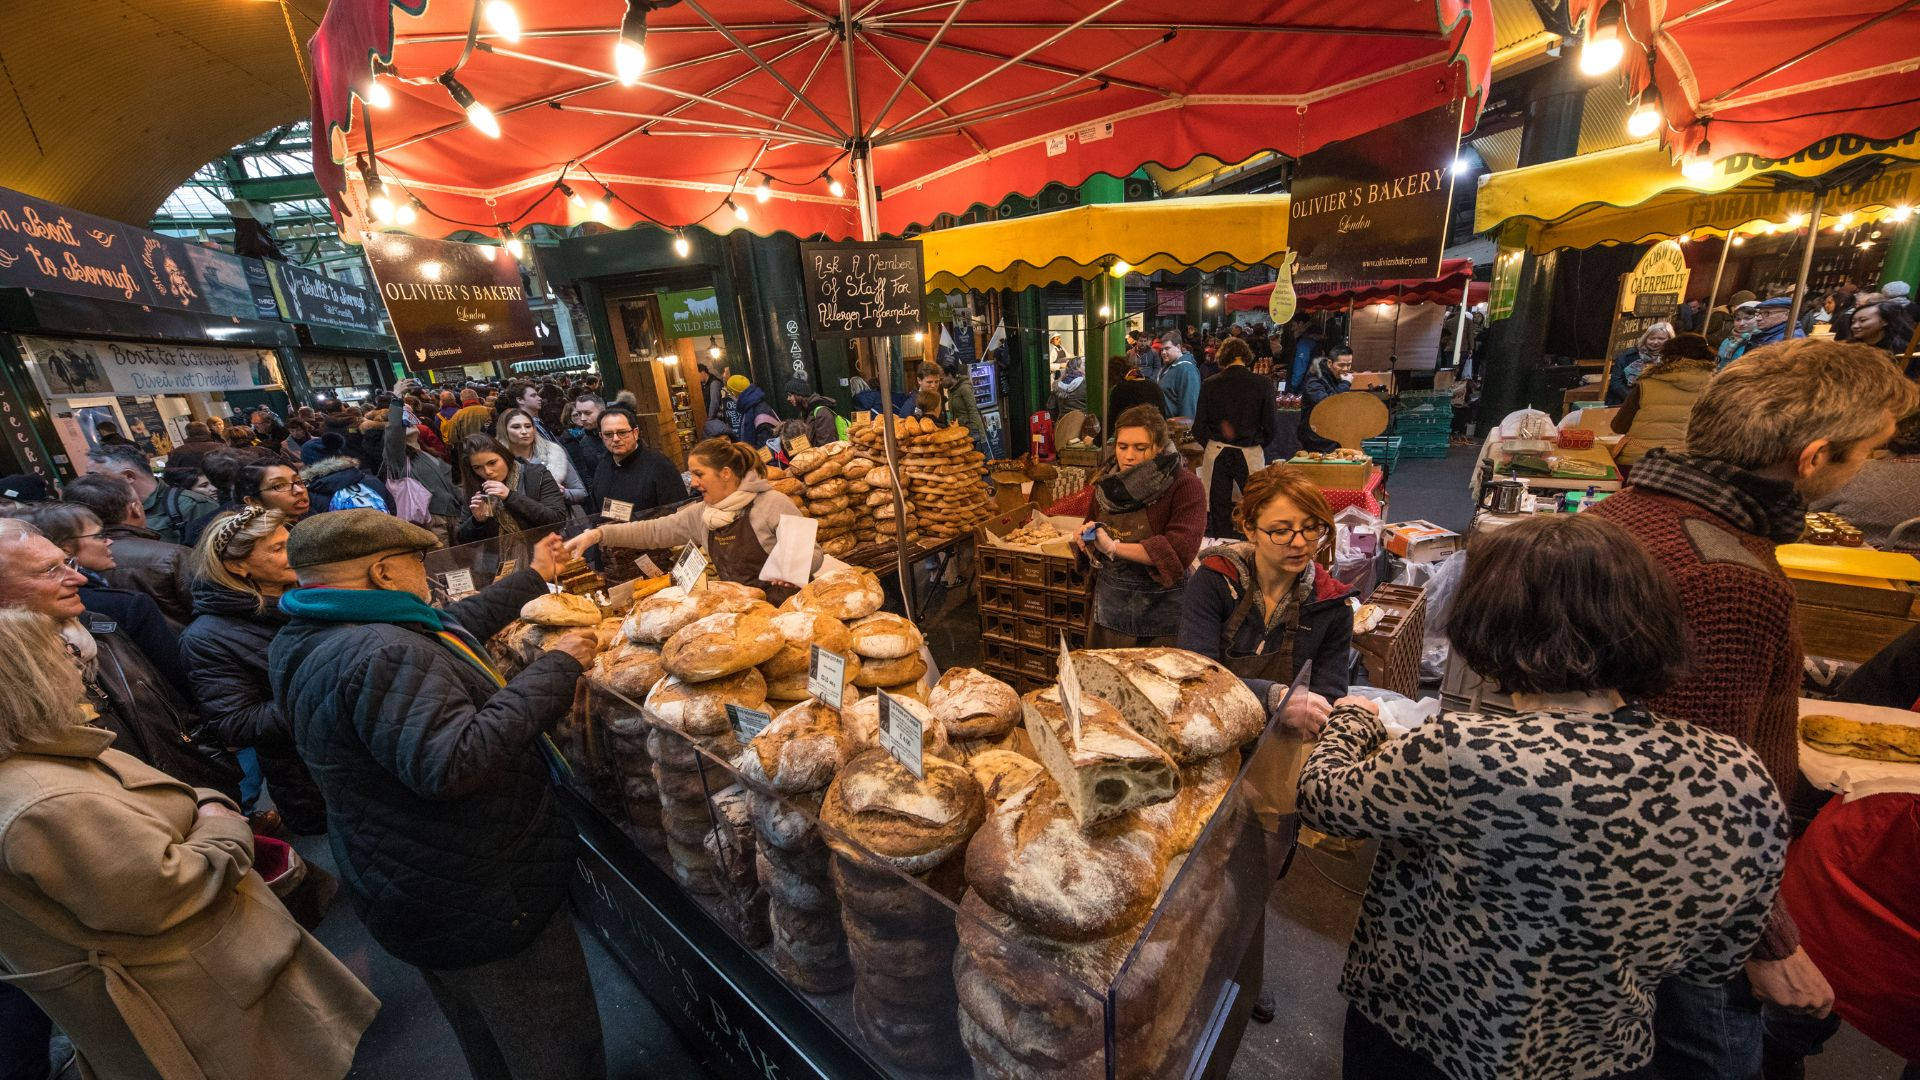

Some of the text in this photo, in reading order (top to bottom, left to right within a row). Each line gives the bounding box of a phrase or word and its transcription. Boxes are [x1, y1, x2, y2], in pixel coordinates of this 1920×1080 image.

[1292, 168, 1447, 219] OLIVIER'S BAKERY
[1337, 214, 1371, 234] London
[25, 243, 58, 277] to
[62, 251, 140, 299] Borough
[852, 255, 865, 279] A
[385, 282, 522, 301] OLIVIER'S BAKERY
[822, 277, 840, 302] Of
[845, 275, 886, 304] Staff
[1631, 273, 1686, 294] CAERPHILLY
[456, 306, 486, 322] London
[673, 319, 721, 333] WILD BEE
[131, 371, 239, 390] Dived not Dredged
[707, 993, 792, 1080] BAK
